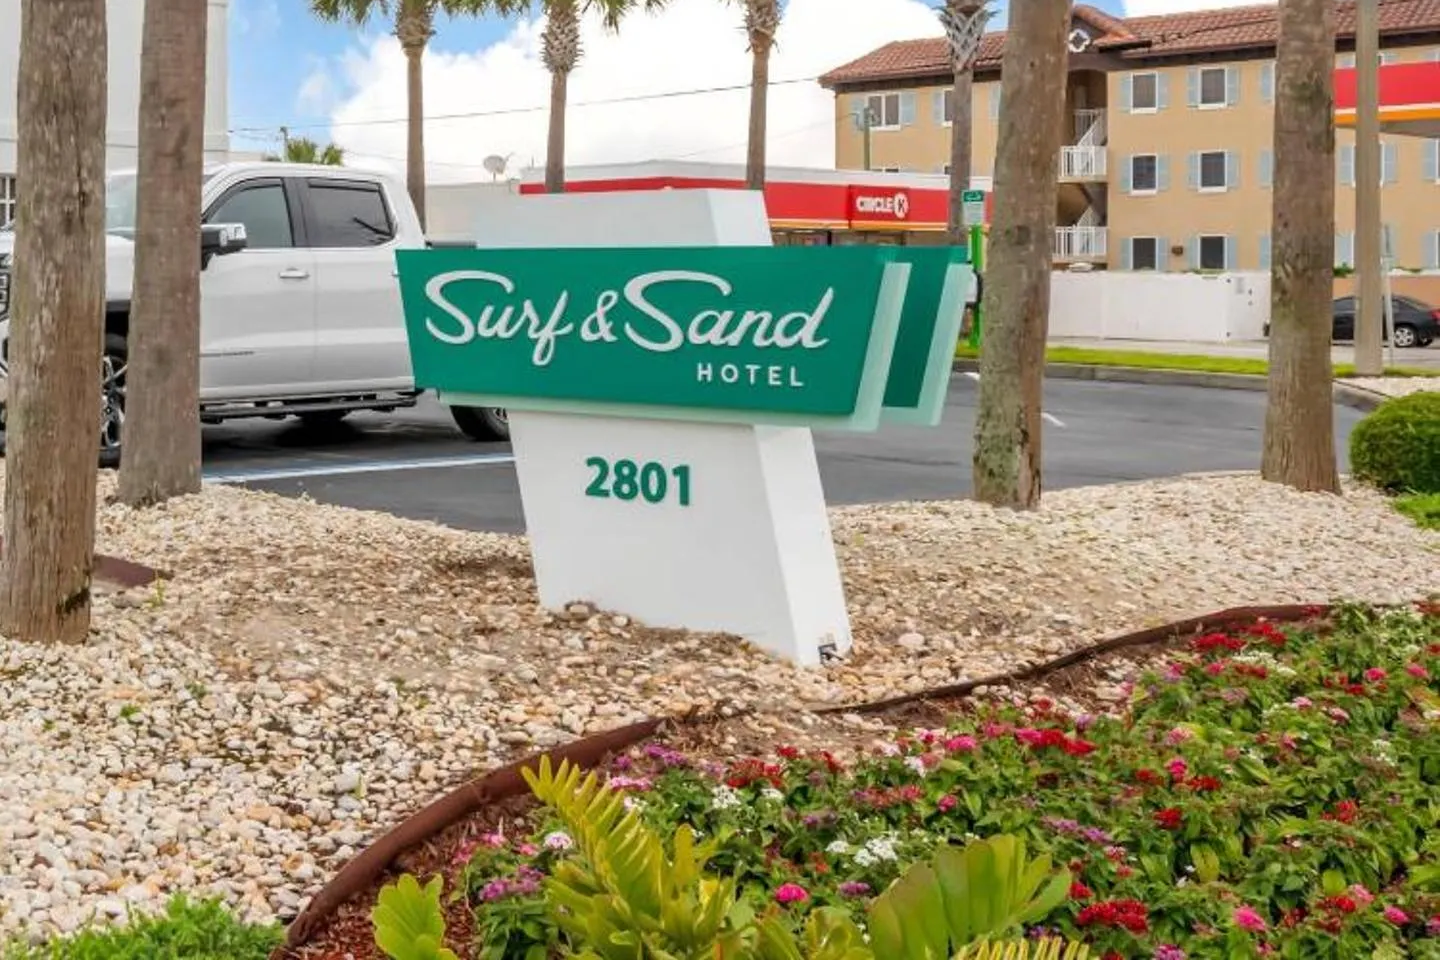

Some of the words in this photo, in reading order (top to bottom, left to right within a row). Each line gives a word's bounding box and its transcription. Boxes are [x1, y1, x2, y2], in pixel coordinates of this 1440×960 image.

[855, 195, 894, 213] CIRCLE
[425, 269, 574, 366] Surf
[580, 290, 619, 342] &
[623, 269, 834, 352] Sand
[696, 362, 805, 387] HOTEL
[585, 456, 690, 506] 2801
